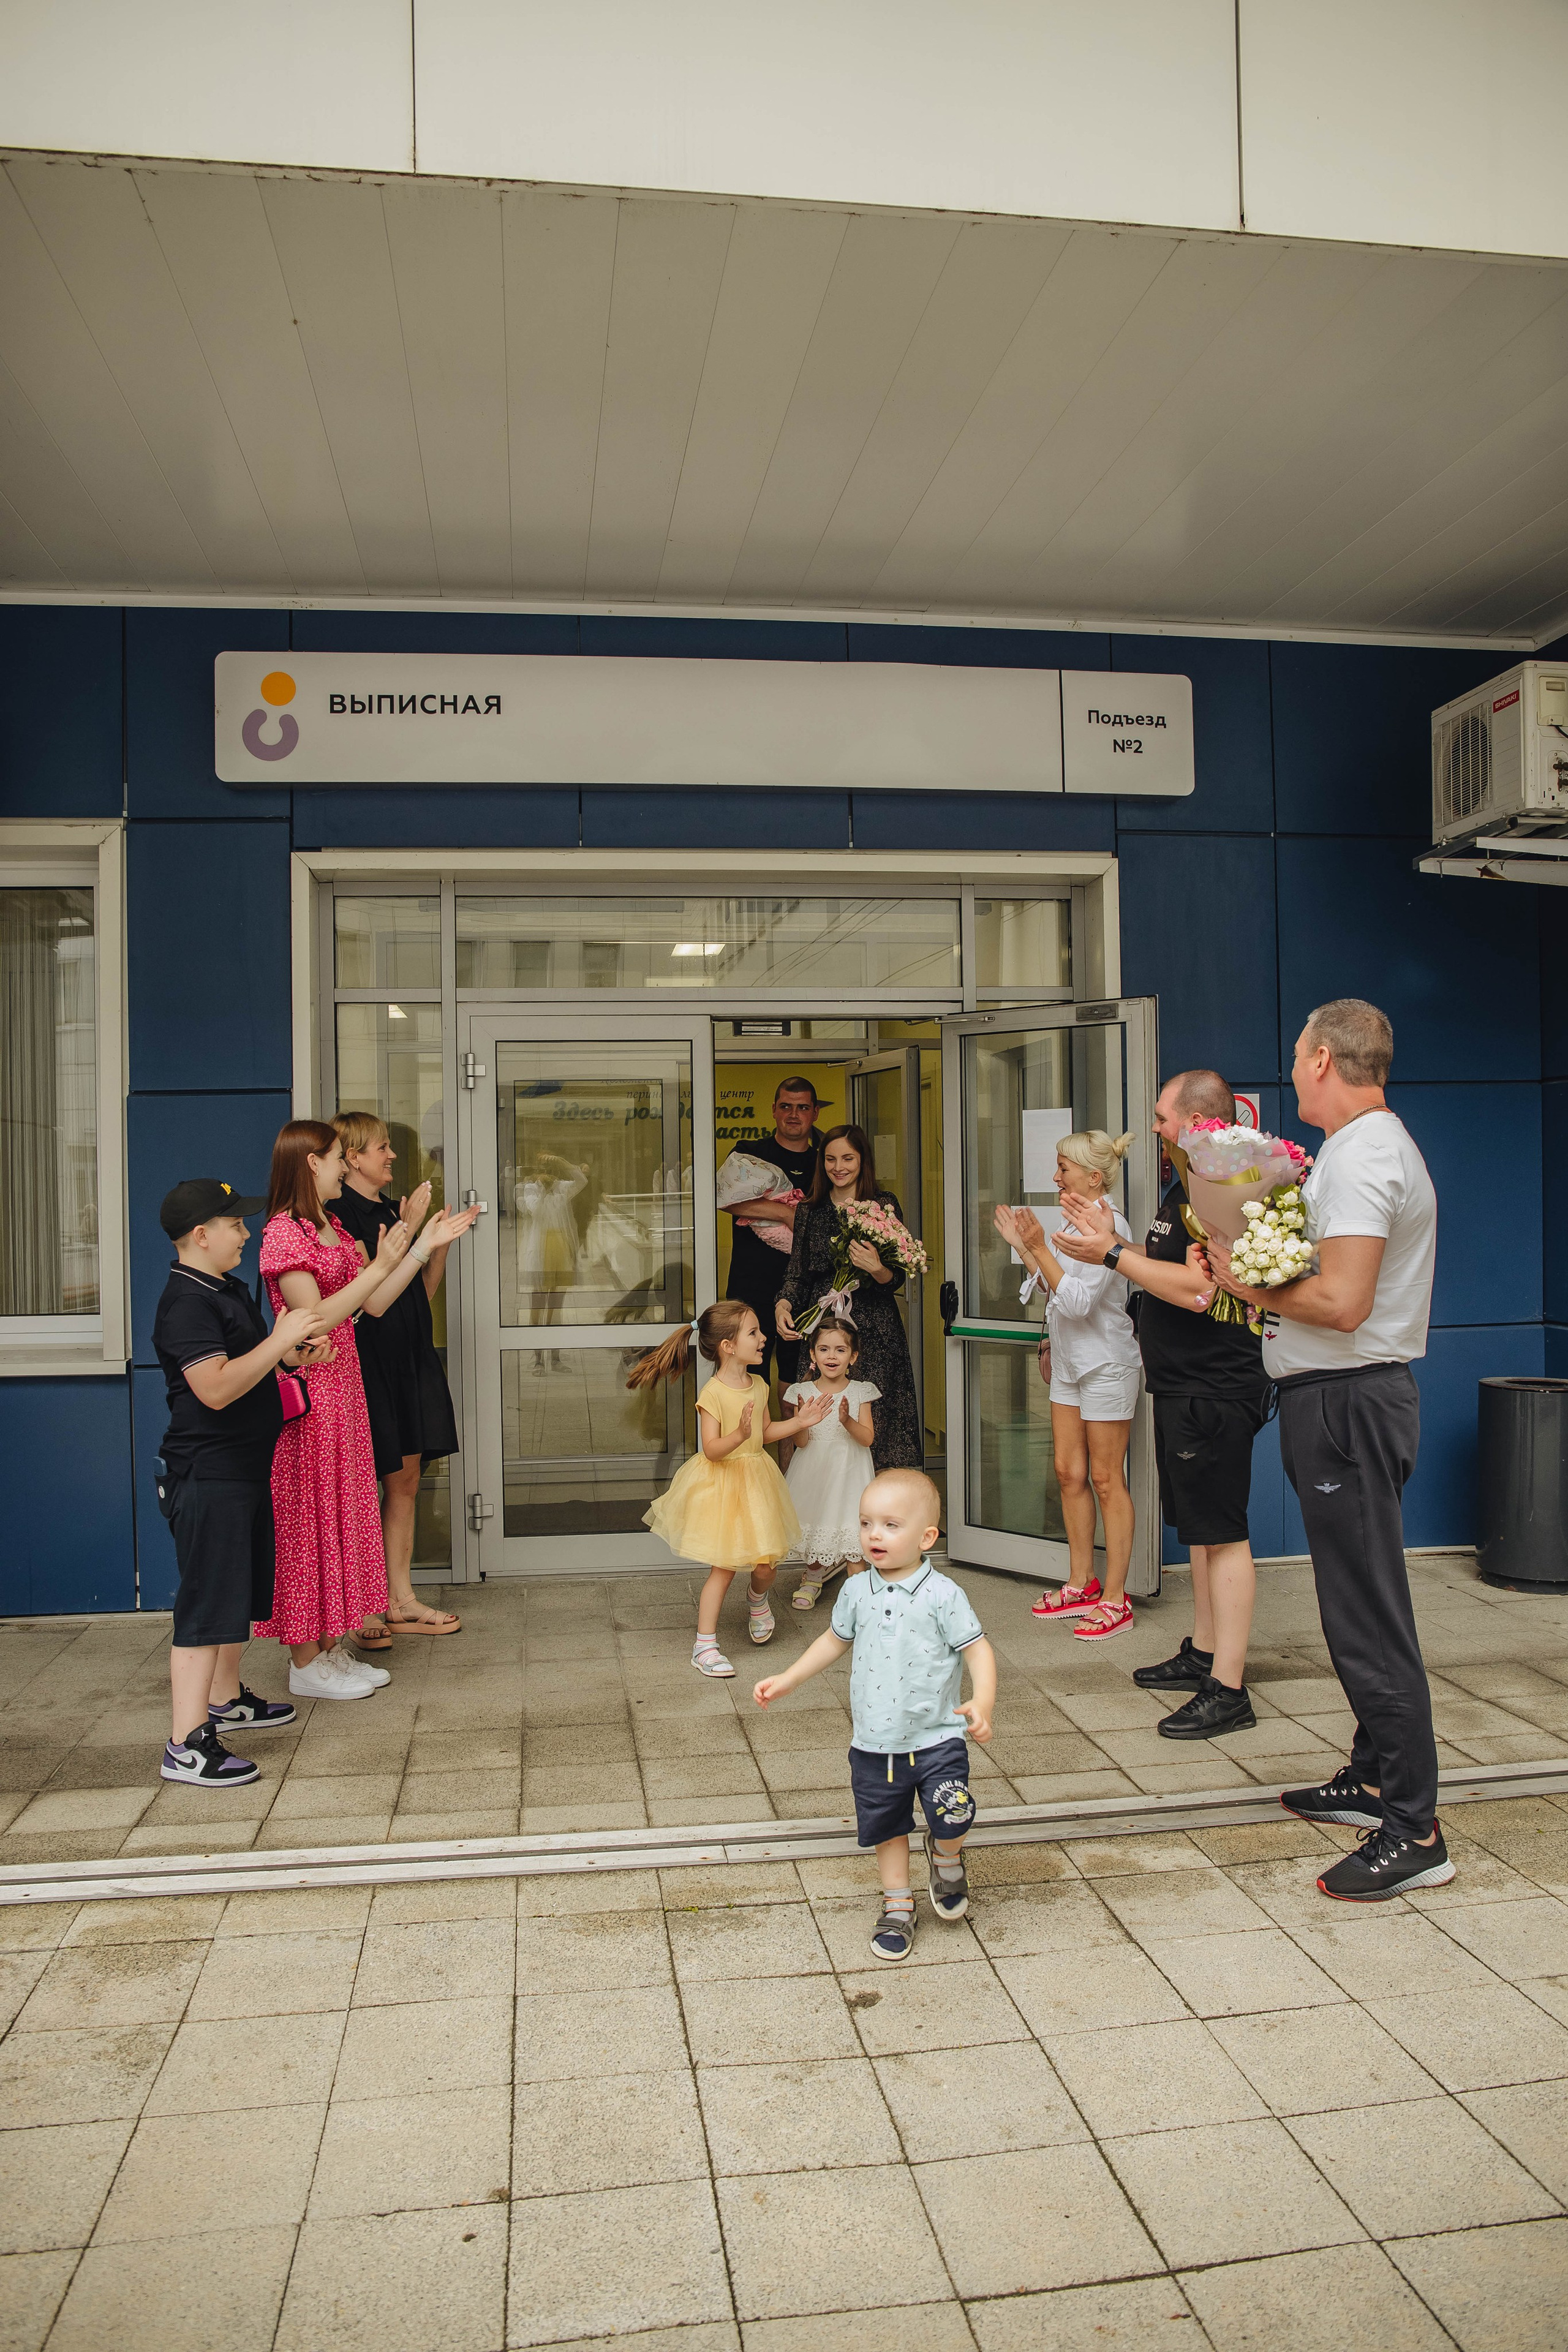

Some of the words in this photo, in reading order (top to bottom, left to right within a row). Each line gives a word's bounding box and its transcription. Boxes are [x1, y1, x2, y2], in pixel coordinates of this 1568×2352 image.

[329, 693, 502, 715] ВЫПИСНАЯ
[1495, 693, 1517, 709] SHIVAKI
[1088, 709, 1167, 729] Подъезд
[1112, 739, 1144, 754] №2
[720, 1090, 755, 1102] центр
[552, 1101, 614, 1120] Здесь
